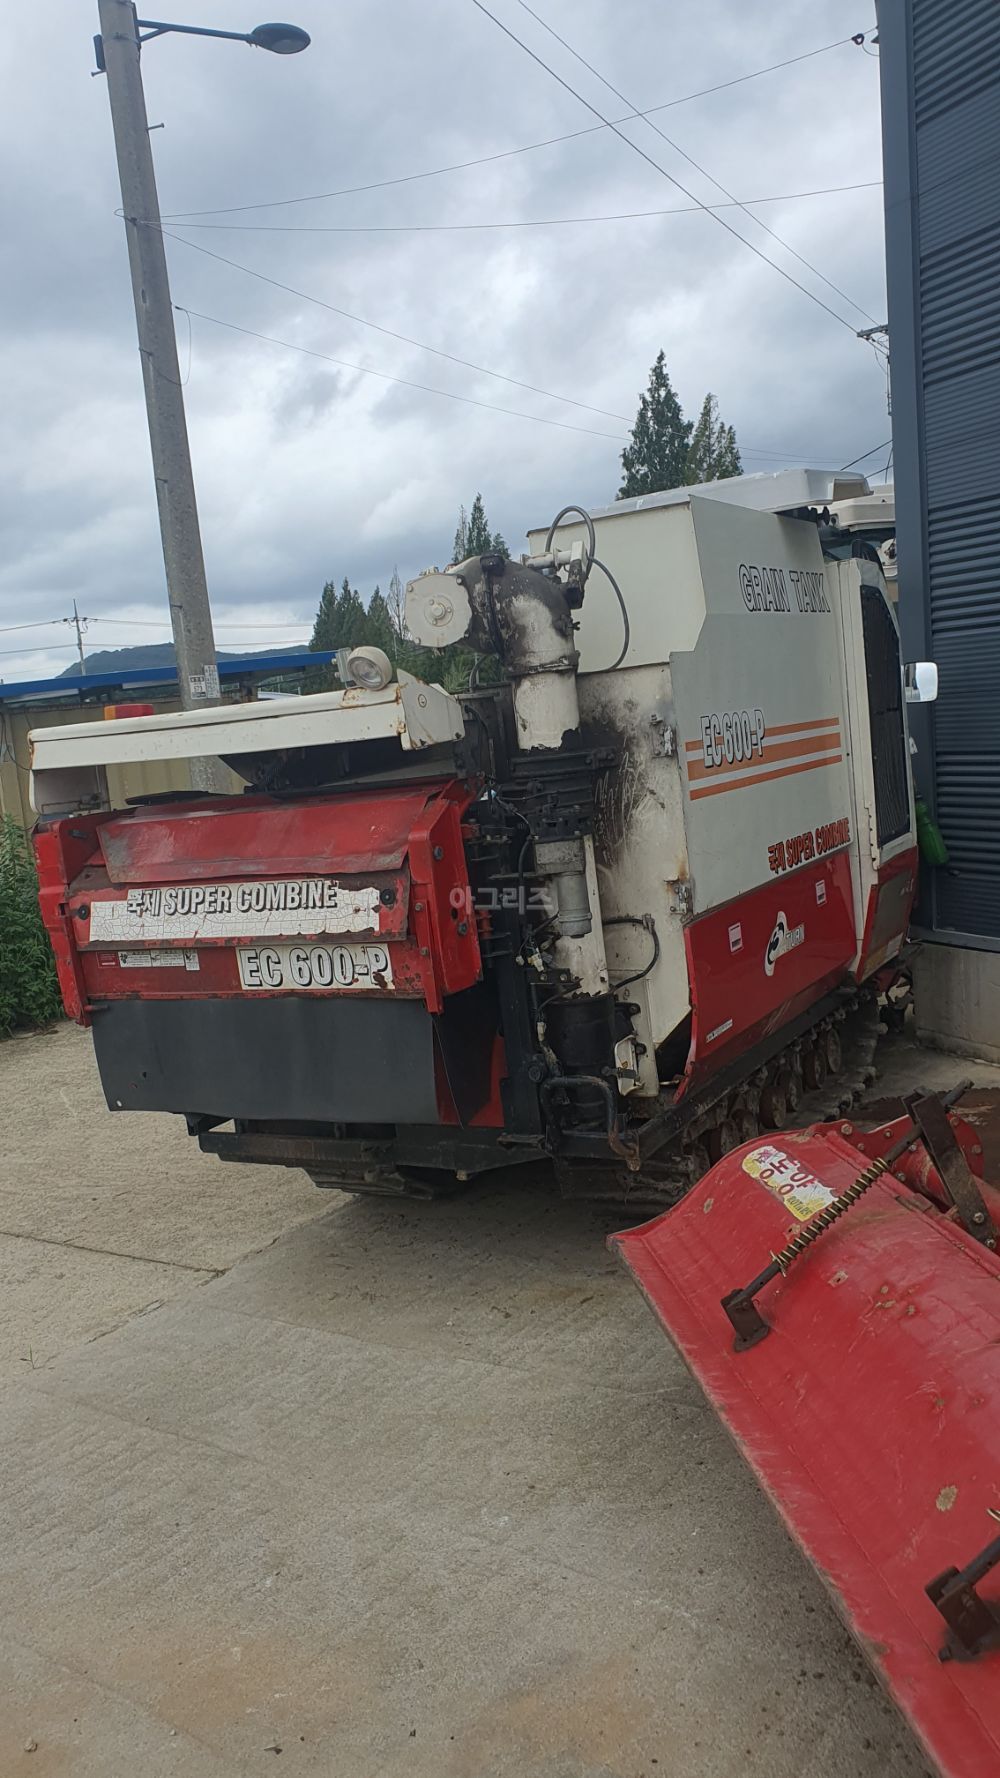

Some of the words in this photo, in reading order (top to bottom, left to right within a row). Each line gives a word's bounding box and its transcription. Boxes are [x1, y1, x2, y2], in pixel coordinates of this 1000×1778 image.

[738, 564, 791, 613] GRAIN
[789, 570, 831, 613] TANK
[785, 831, 815, 868] SUPER
[814, 817, 850, 855] COMBINE
[127, 888, 161, 917] 국제
[164, 886, 231, 916] SUPER
[237, 881, 338, 912] COMBINE
[239, 947, 283, 988] EC
[289, 945, 389, 988] 600-P
